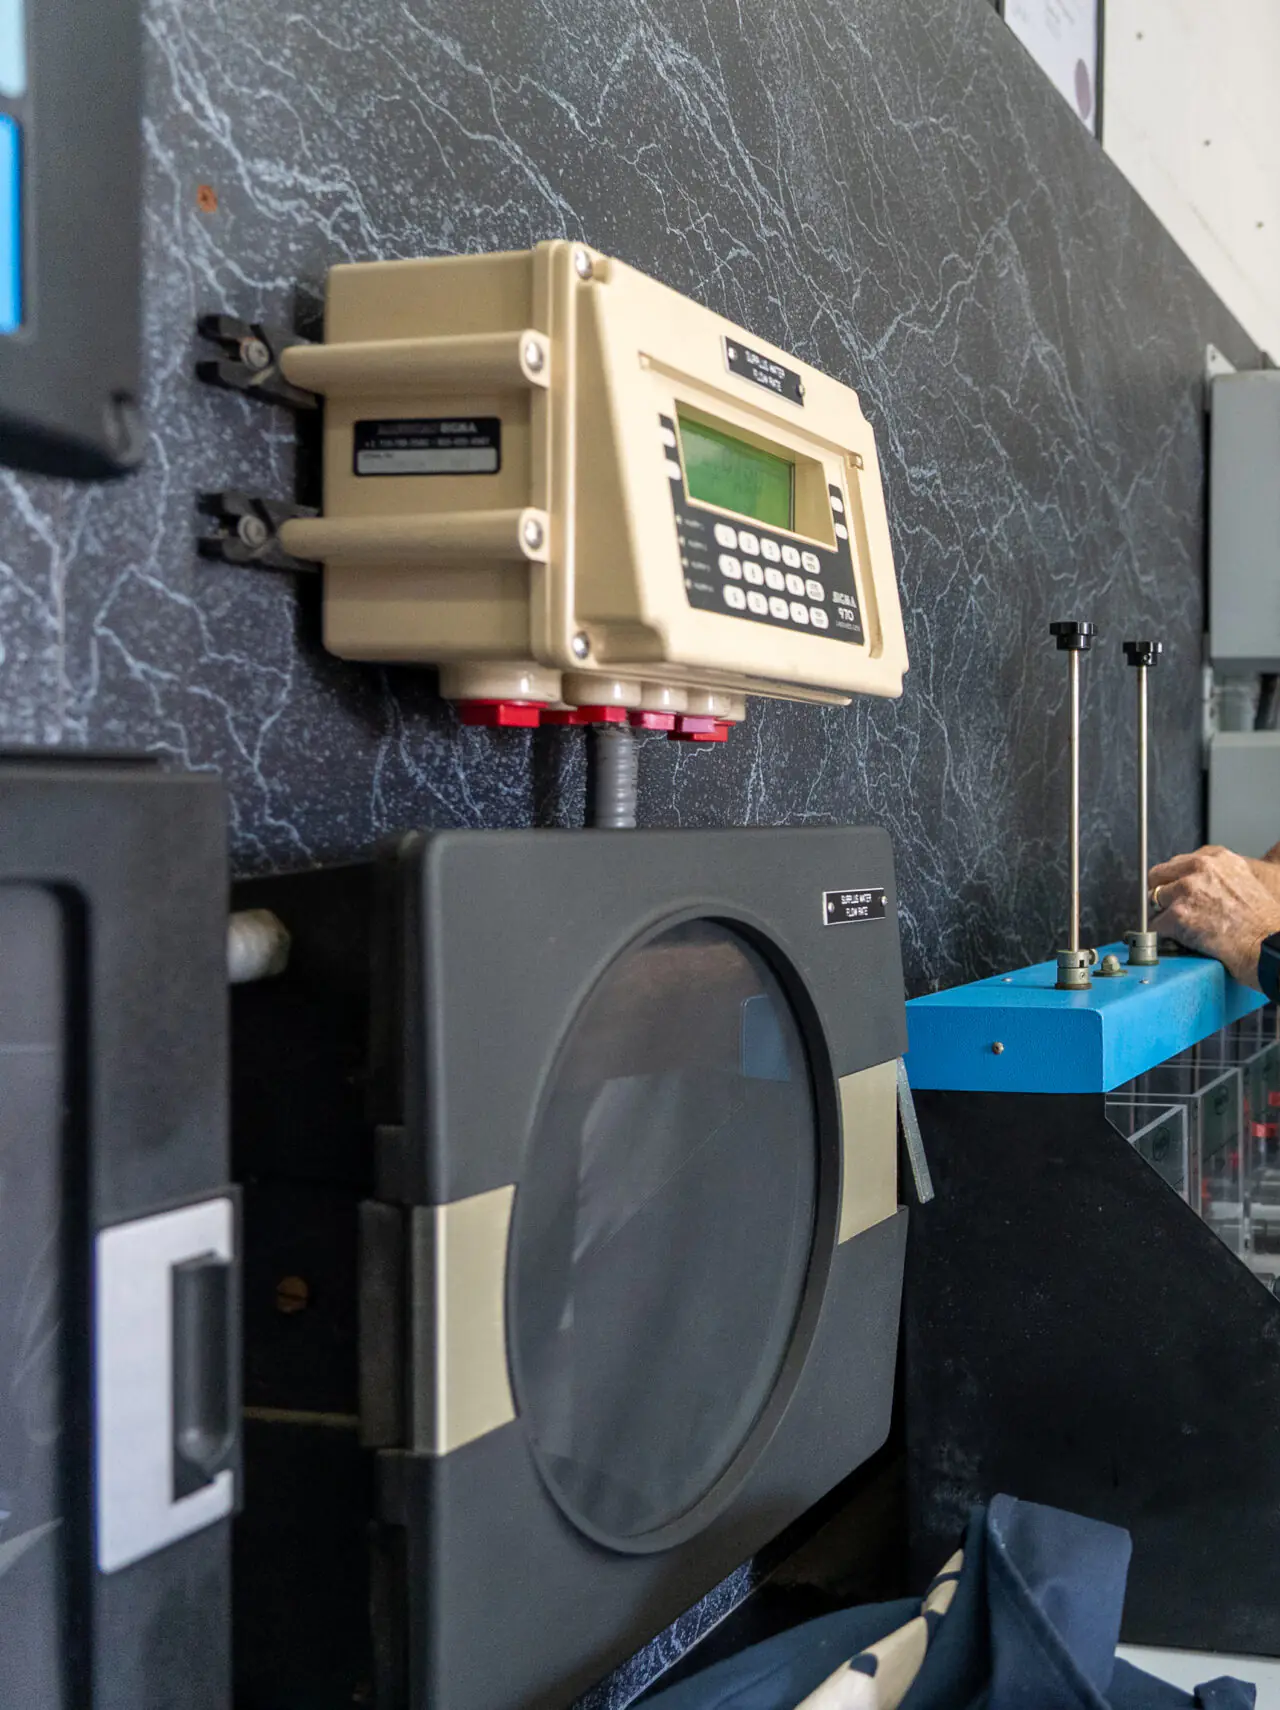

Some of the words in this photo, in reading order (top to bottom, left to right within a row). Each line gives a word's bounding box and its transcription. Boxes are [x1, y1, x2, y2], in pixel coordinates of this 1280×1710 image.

[841, 894, 859, 905] SURPLUS
[859, 893, 872, 903] WATER
[845, 907, 858, 917] FLOW
[858, 906, 869, 916] RATE
